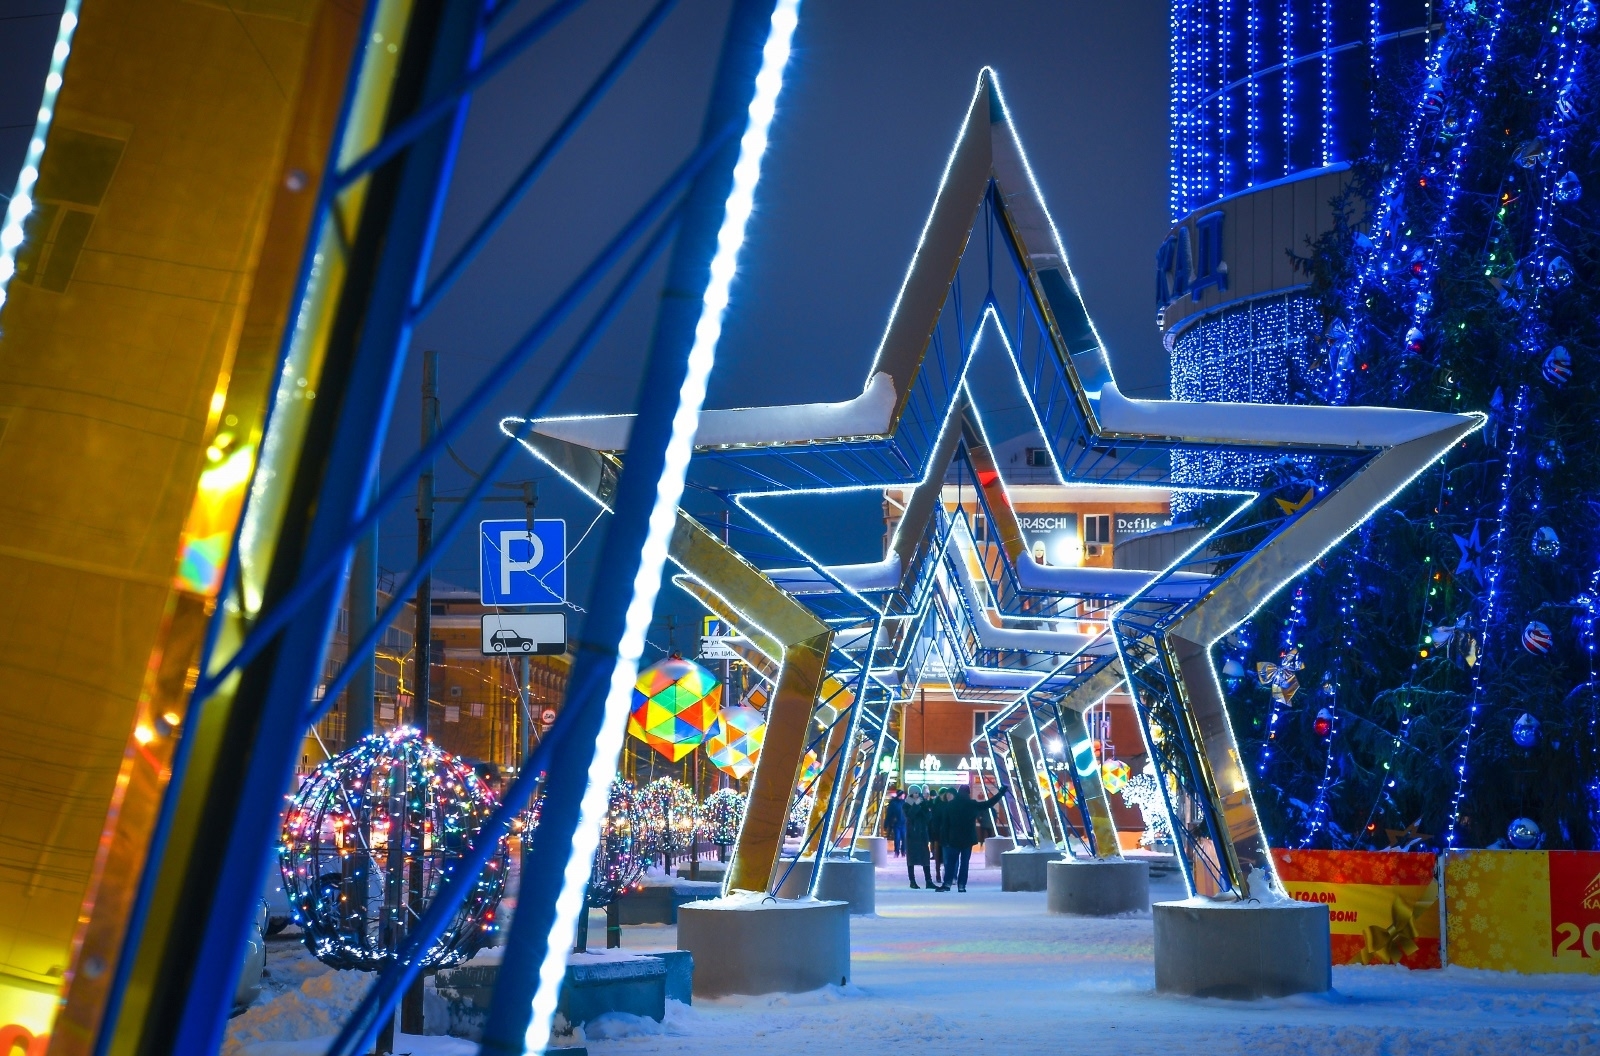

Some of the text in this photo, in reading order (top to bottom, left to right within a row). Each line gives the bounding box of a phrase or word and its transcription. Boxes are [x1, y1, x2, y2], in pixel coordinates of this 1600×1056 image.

[1017, 517, 1067, 530] BRASCHI
[1116, 517, 1157, 530] Defile
[500, 530, 544, 595] P
[1295, 891, 1337, 904] ГОДОМ
[1555, 921, 1600, 958] 20
